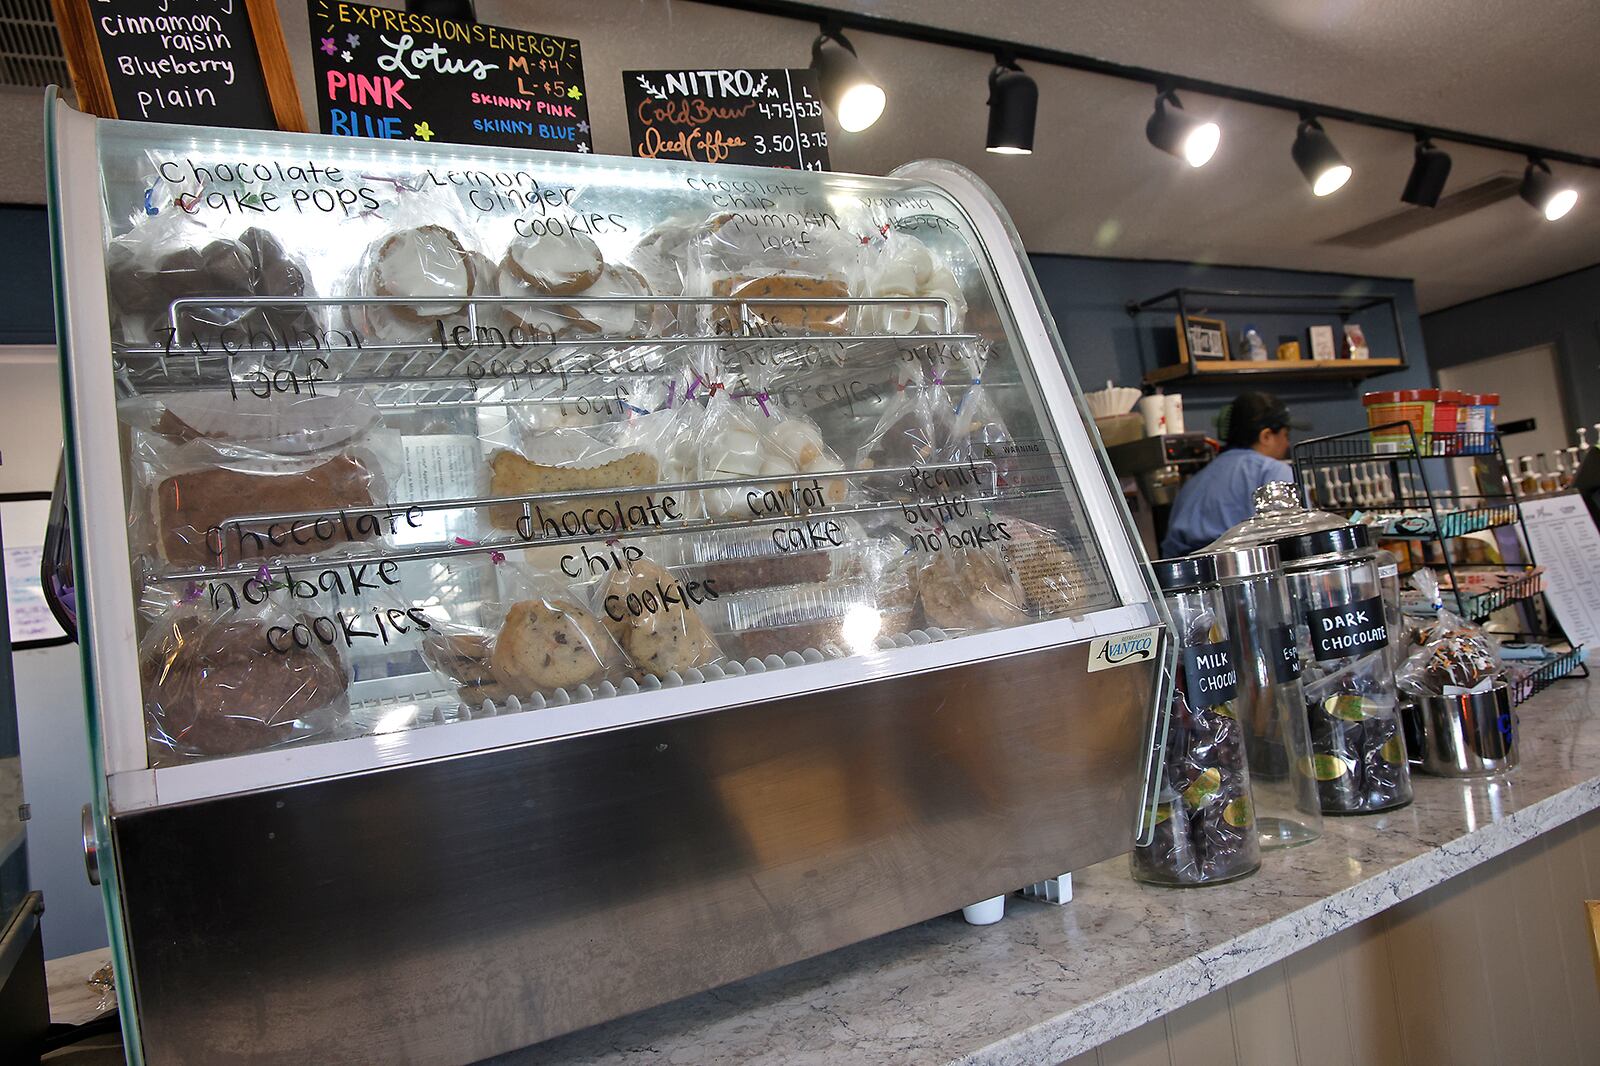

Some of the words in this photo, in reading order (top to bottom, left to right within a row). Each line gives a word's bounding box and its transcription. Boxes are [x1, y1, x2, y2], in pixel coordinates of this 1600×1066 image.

[101, 14, 222, 36] cinnamon
[339, 4, 485, 44] EXPRESSIONS
[489, 26, 566, 60] ENERGY
[161, 32, 232, 52] raisin
[377, 34, 499, 80] Lotus
[118, 56, 235, 85] Blueberry
[326, 70, 413, 110] PINK
[665, 70, 754, 98] NITRO
[767, 88, 779, 98] M
[803, 86, 812, 98] L
[137, 86, 217, 118] plain
[471, 92, 533, 111] SKINNY
[536, 101, 576, 118] PINK
[759, 103, 793, 119] 4.75
[798, 101, 821, 118] 5.25
[472, 119, 532, 135] SKINNY
[539, 124, 576, 141] BLUE
[800, 132, 828, 148] 3.75
[754, 136, 794, 154] 3.50
[514, 211, 628, 239] cookies
[1002, 445, 1040, 453] WARNING
[516, 495, 683, 543] chocolate
[772, 520, 844, 551] cake
[560, 545, 644, 578] chip
[208, 578, 269, 611] no
[284, 559, 400, 600] bake
[604, 578, 719, 622] cookies
[267, 606, 433, 654] cookies
[1321, 610, 1369, 632] DARK
[1321, 626, 1387, 651] CHOCOLATE
[1196, 652, 1229, 670] MILK
